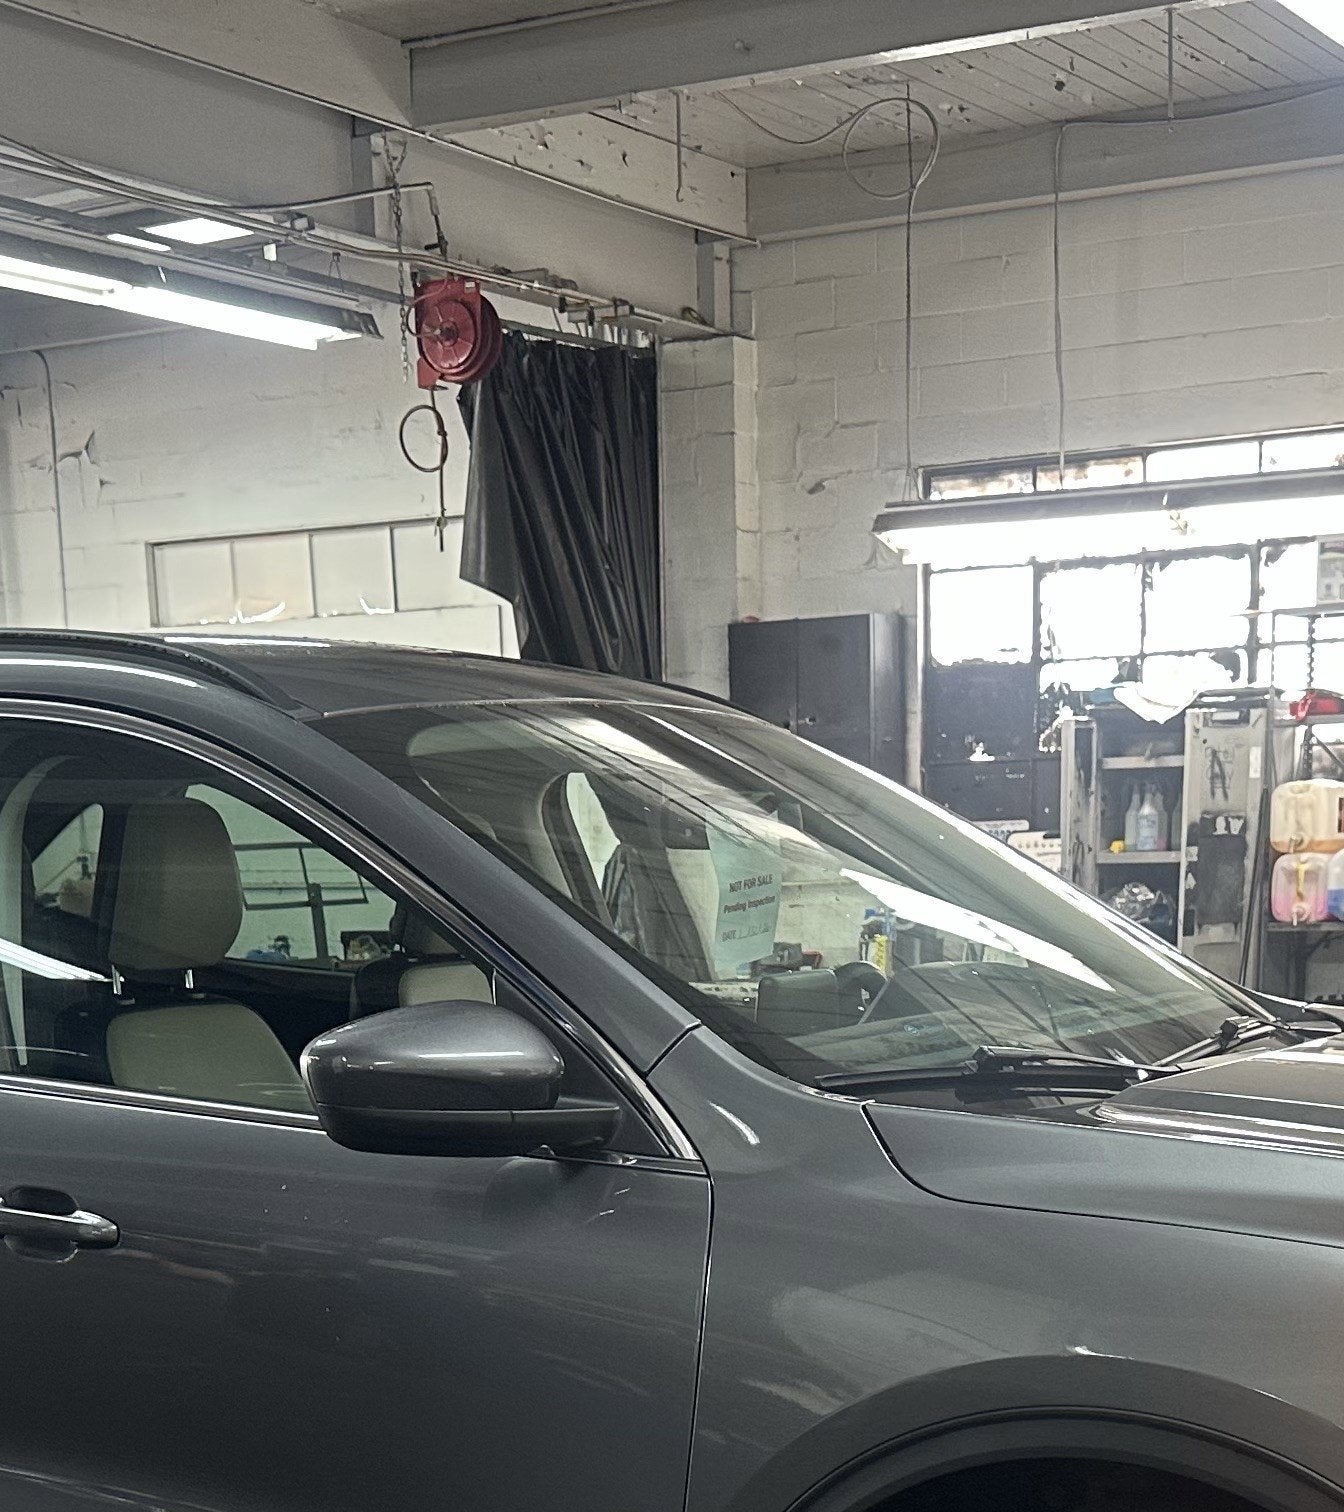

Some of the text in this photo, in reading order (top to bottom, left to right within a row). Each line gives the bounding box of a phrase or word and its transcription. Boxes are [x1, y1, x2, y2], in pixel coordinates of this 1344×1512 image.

[729, 874, 773, 892] NOT FOR SALE
[723, 896, 775, 914] Pending Inspection
